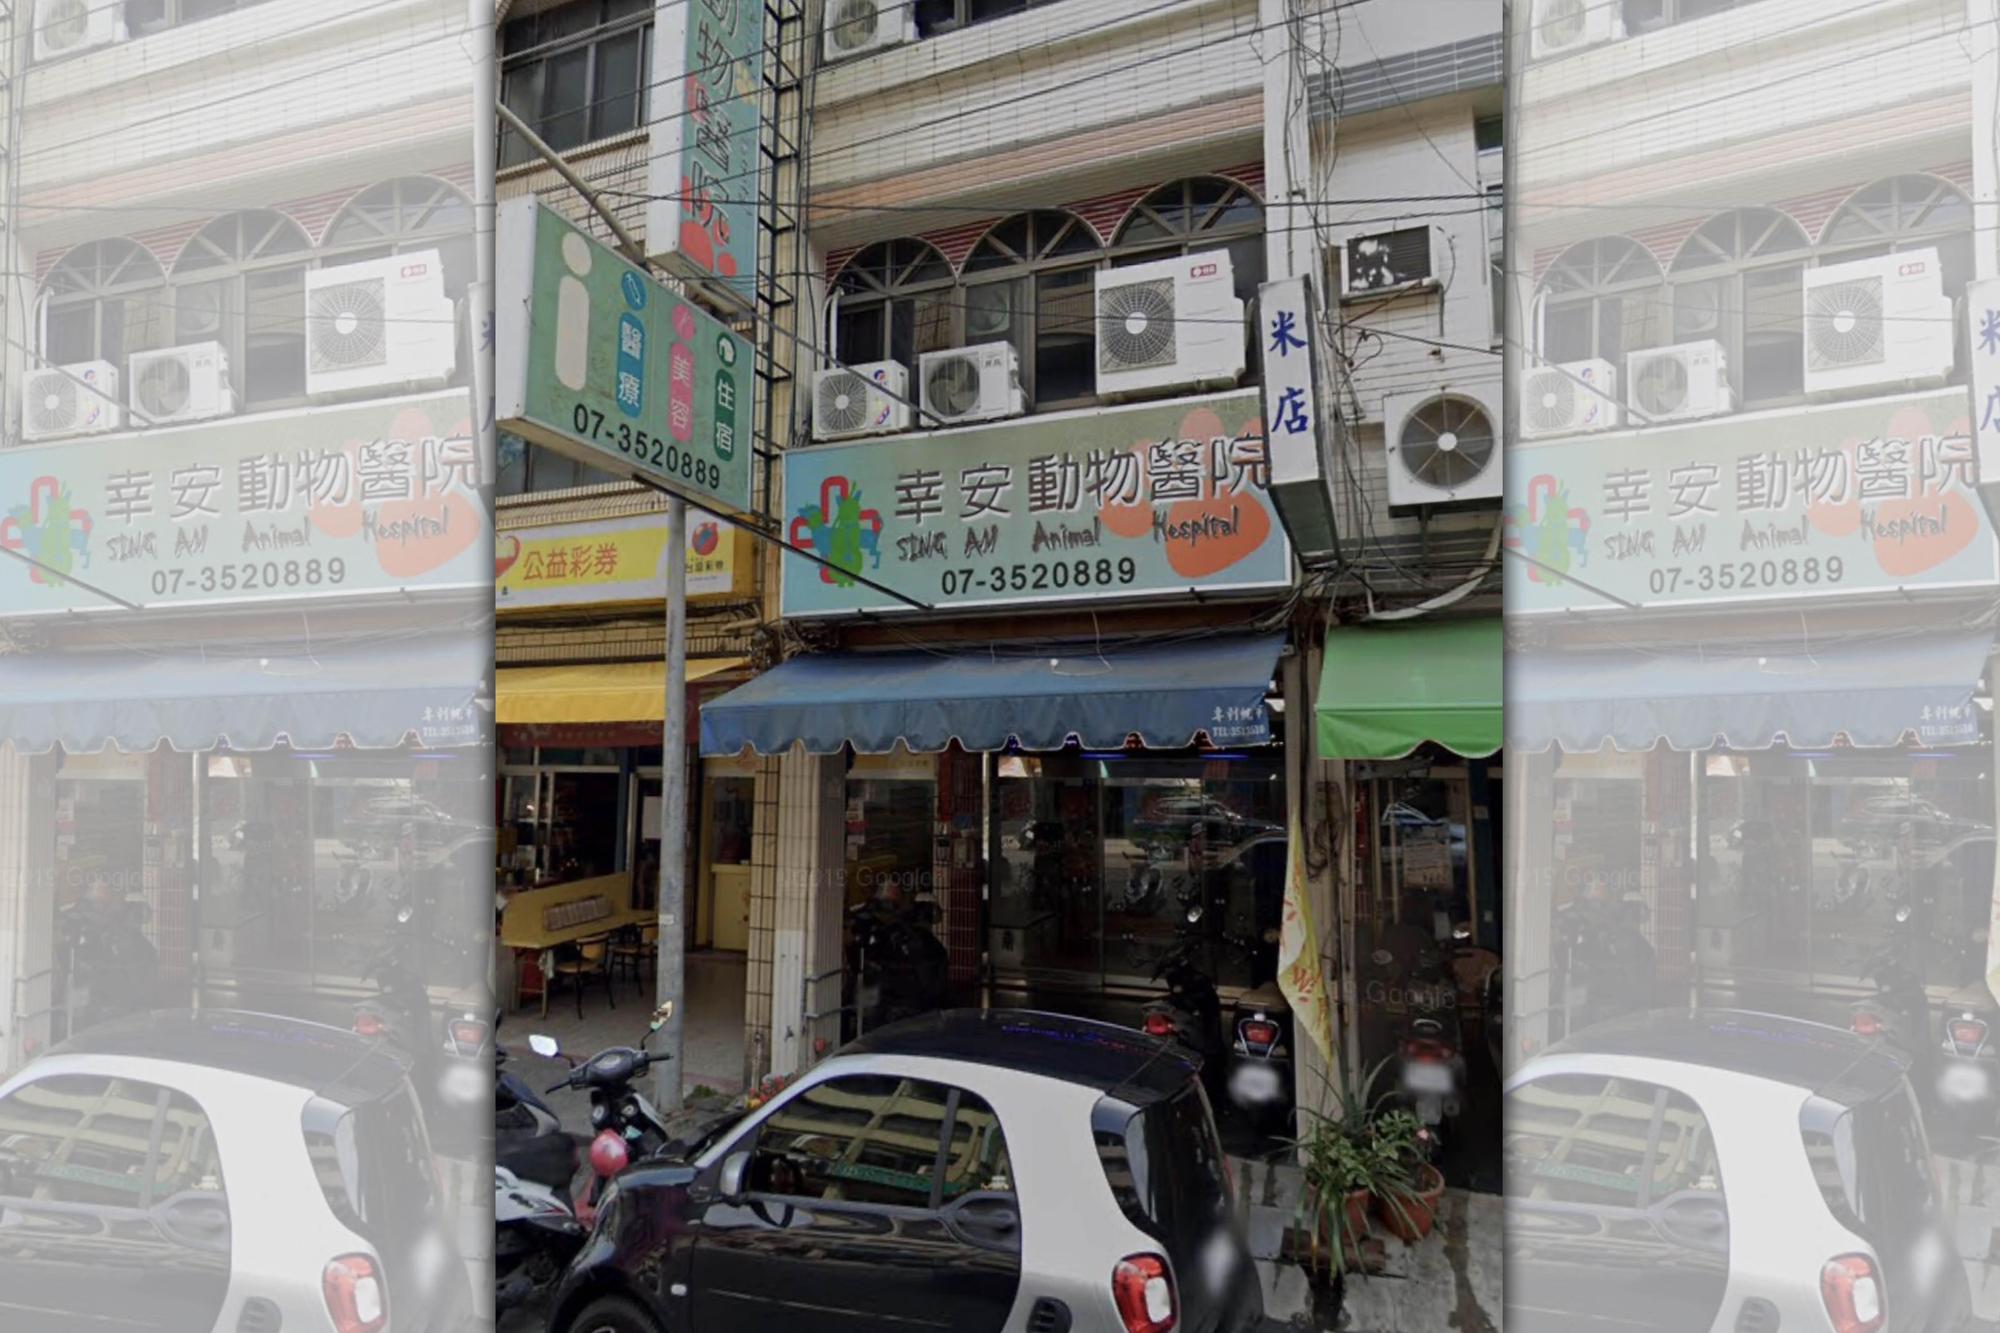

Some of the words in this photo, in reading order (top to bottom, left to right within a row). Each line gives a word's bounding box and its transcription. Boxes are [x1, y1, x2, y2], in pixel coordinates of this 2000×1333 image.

[1269, 310, 1308, 435] 米店
[716, 378, 734, 454] 住宿
[573, 403, 720, 490] 07-3520889
[103, 432, 478, 526] 幸安動物醫院
[893, 432, 1268, 526] 幸安動物醫院
[1601, 431, 1976, 525] 幸安動物醫院
[106, 531, 157, 562] SING
[242, 516, 310, 552] Animal
[363, 506, 449, 547] Hospital
[896, 531, 947, 562] SING
[1032, 516, 1100, 552] Animal
[1153, 506, 1239, 547] Hospital
[1604, 530, 1655, 561] SING
[1740, 515, 1808, 551] Animal
[1861, 505, 1947, 546] Hospital
[151, 556, 346, 595] 07-3520889
[523, 543, 618, 580] 公益彩券
[941, 556, 1136, 595] 07-3520889
[1649, 555, 1844, 594] 07-3520889
